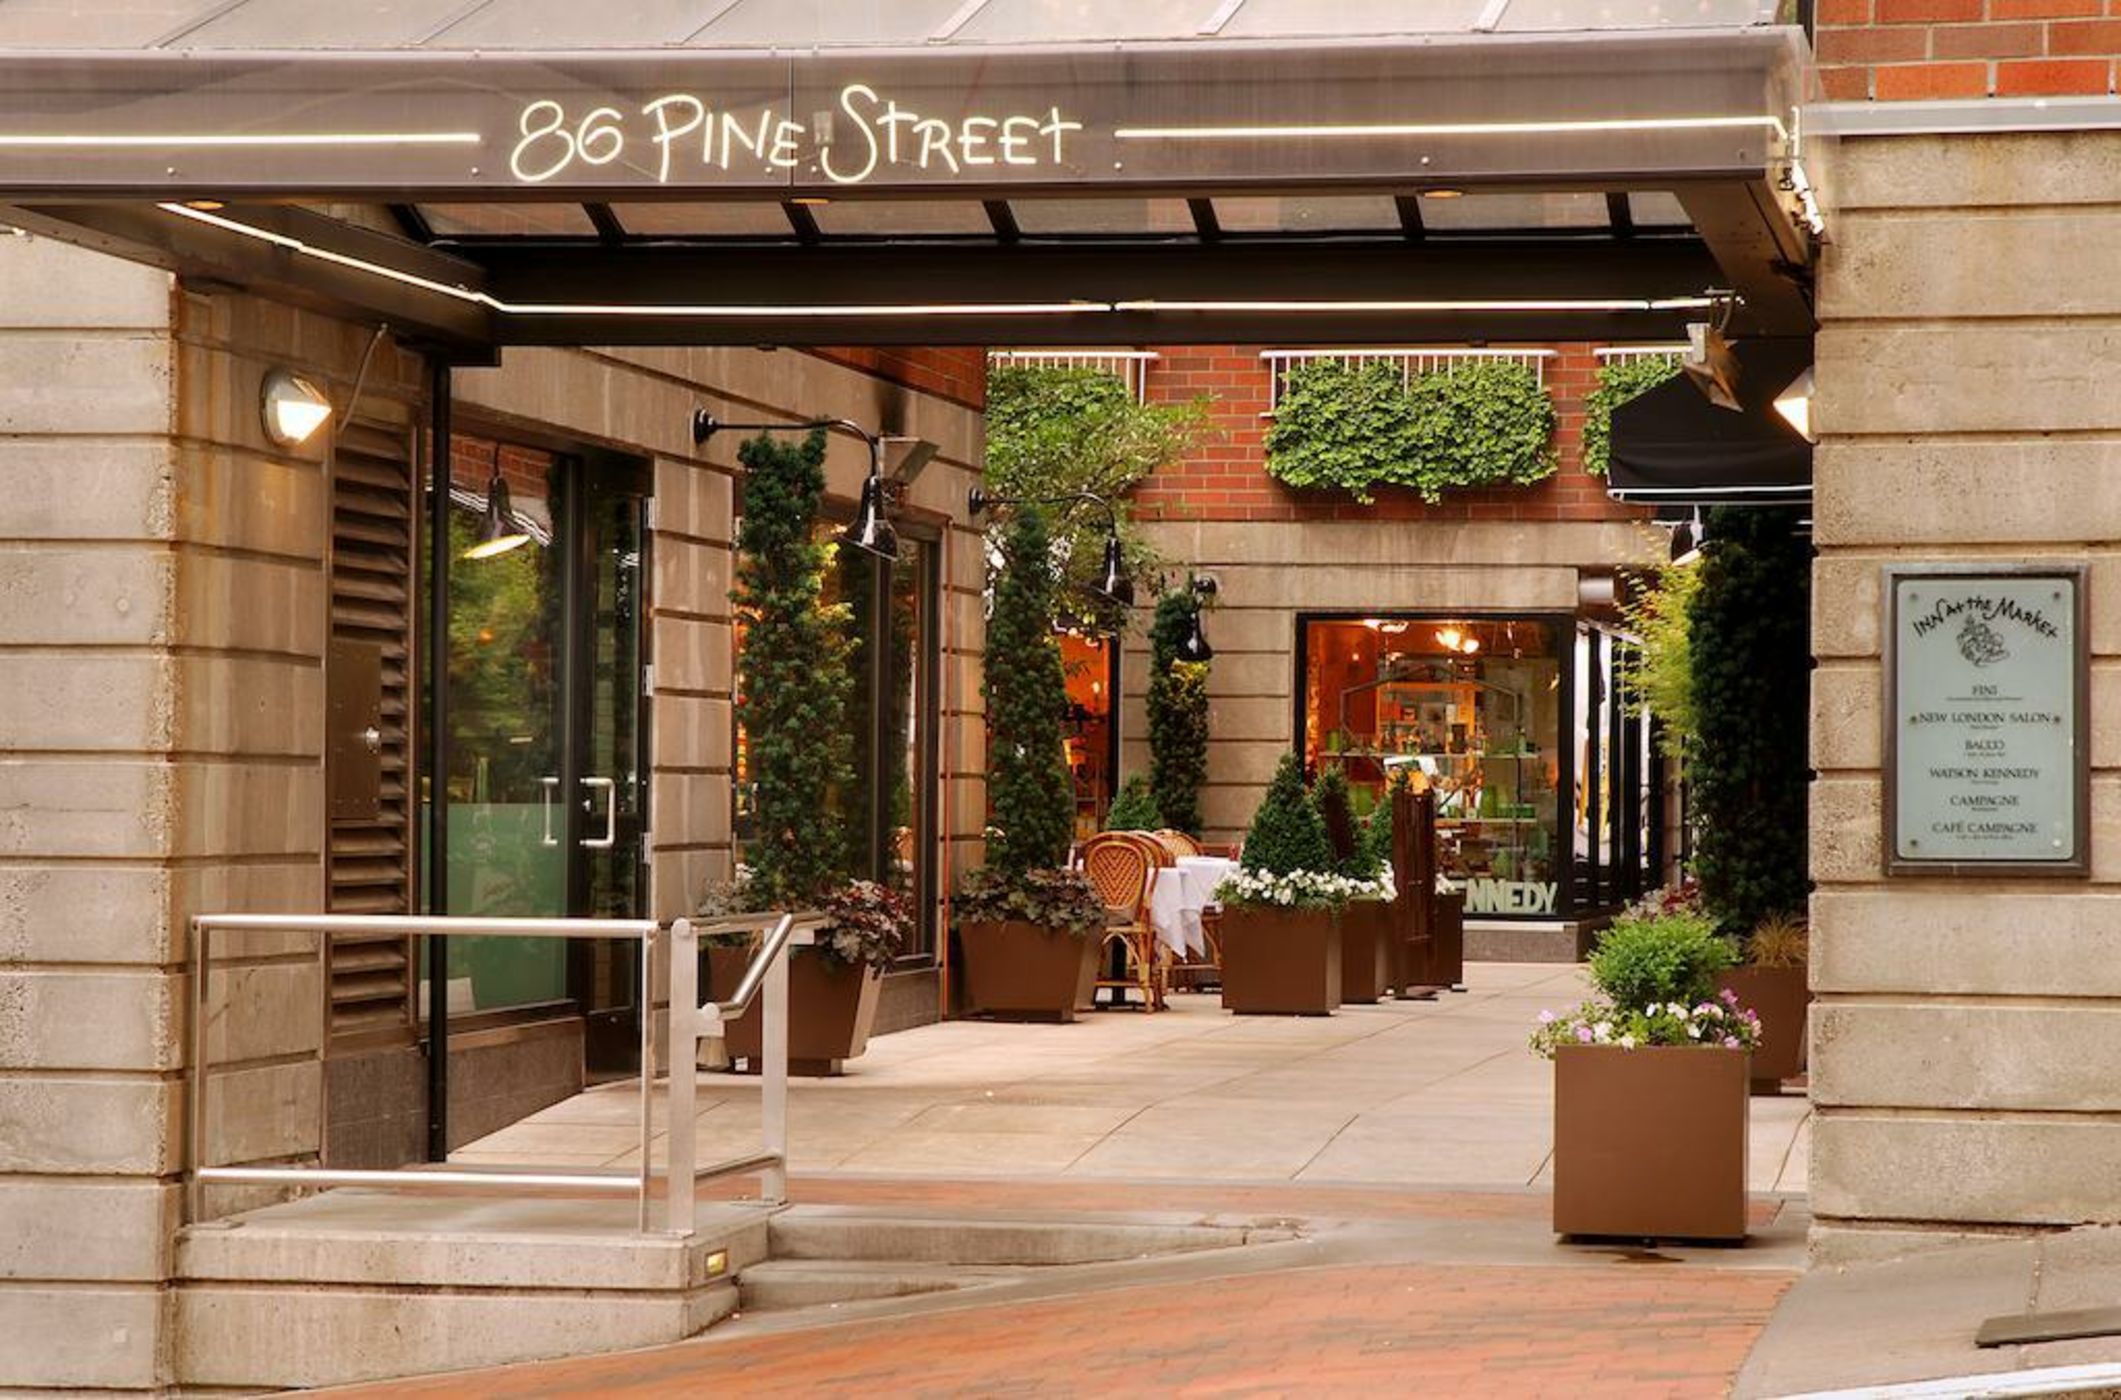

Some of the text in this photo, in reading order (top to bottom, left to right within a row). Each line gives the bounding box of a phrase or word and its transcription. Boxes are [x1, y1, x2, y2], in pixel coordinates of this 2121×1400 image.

[511, 100, 624, 182] 86
[643, 94, 806, 183] PINE
[1919, 712, 2051, 723] NEW LONDON SALON
[1929, 767, 2040, 779] WATSON KENNEDY
[1949, 795, 2020, 807] CAMPAGNE
[1967, 822, 2038, 834] CAMPAGNE
